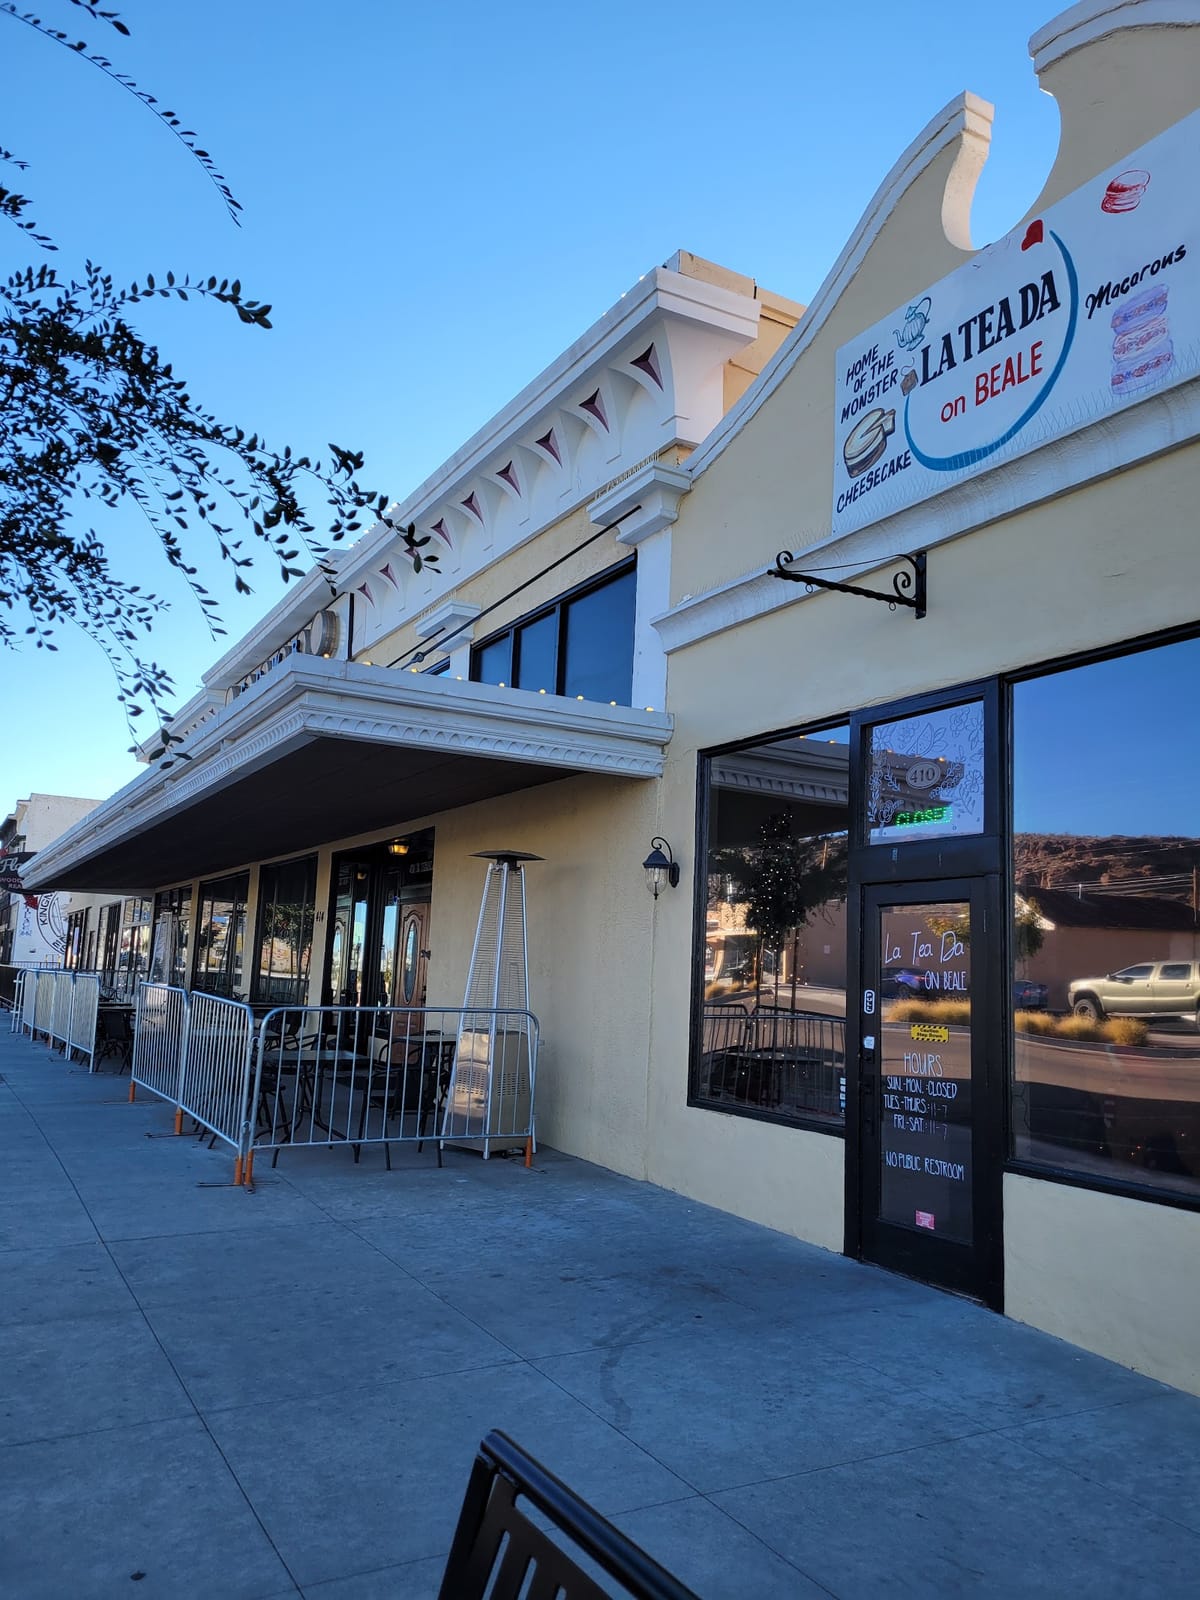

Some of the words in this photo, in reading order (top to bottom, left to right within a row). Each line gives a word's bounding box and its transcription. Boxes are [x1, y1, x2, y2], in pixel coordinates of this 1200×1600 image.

[1085, 244, 1187, 320] Macarons
[919, 332, 957, 387] LA
[958, 297, 1017, 362] TEA
[1018, 271, 1061, 328] DA
[846, 344, 879, 386] HOME
[853, 375, 866, 393] OF
[870, 351, 894, 380] THE
[940, 395, 966, 423] on
[975, 340, 1044, 406] BEALE
[840, 368, 898, 424] MONSTER
[836, 450, 912, 514] CHEESECAKE
[909, 767, 936, 784] 410
[885, 933, 902, 964] La
[911, 931, 933, 965] Tea
[940, 931, 965, 963] Da
[924, 970, 939, 990] ON
[943, 971, 967, 991] BEALE
[904, 1052, 943, 1077] HOURS
[886, 1150, 897, 1168] NO
[898, 1152, 921, 1171] PUBLIC
[924, 1157, 965, 1181] RESTROOM
